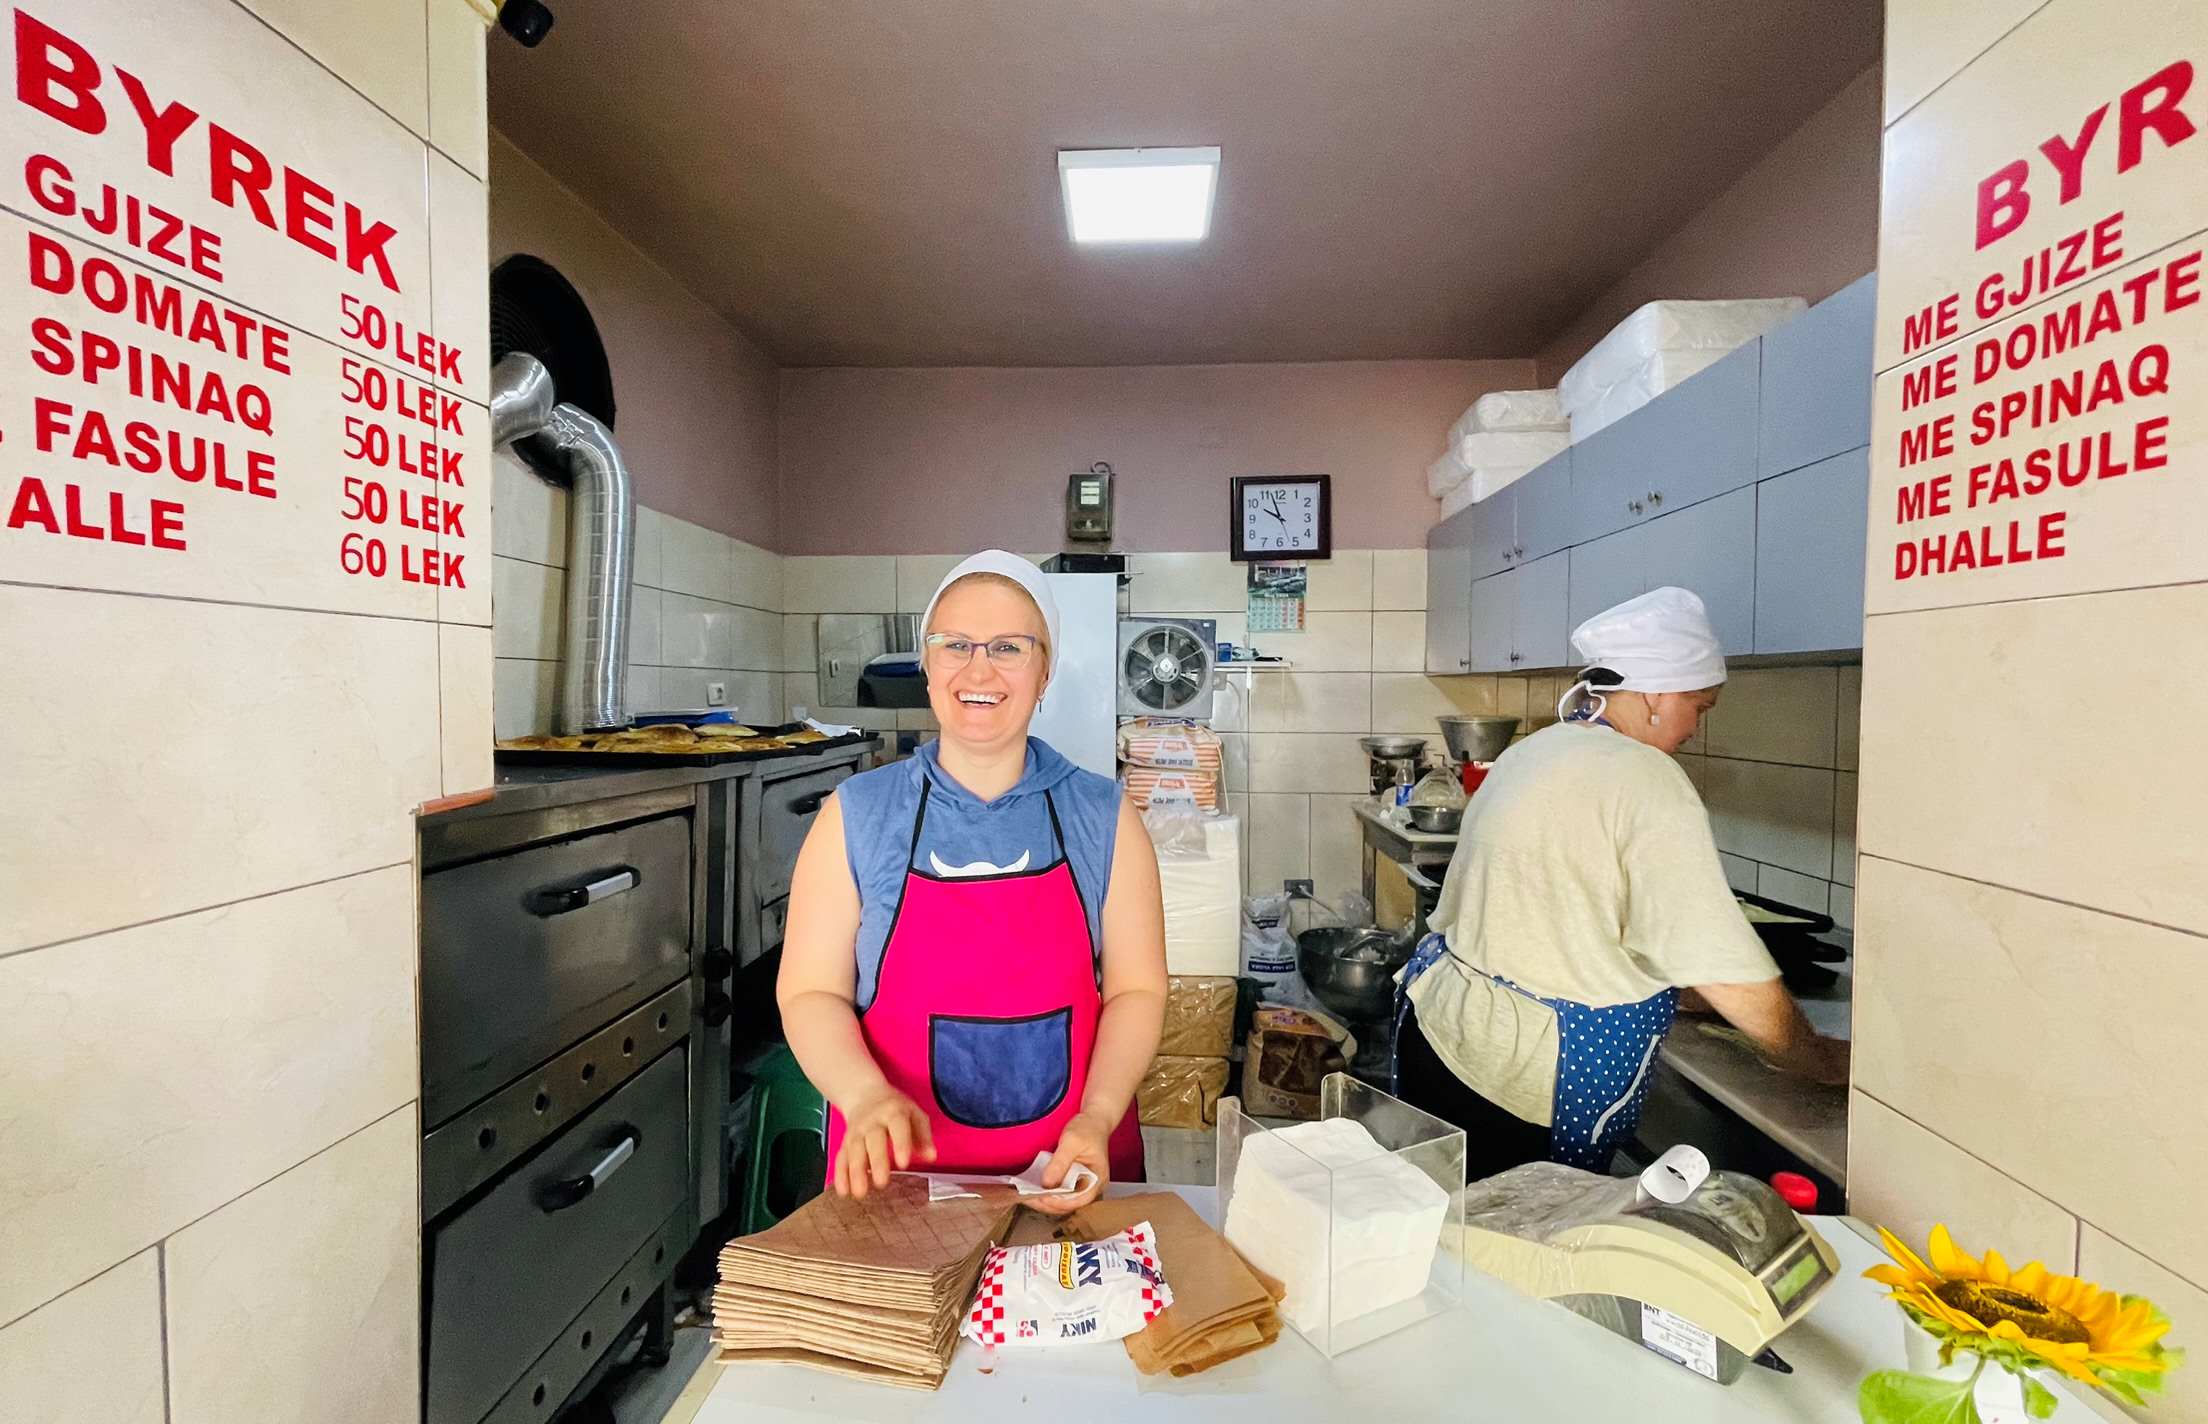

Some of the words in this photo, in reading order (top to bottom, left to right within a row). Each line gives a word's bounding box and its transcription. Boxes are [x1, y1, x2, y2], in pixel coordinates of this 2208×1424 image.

[13, 8, 401, 293] BYREK
[1975, 59, 2208, 252] BYR
[23, 153, 225, 284] GJIZE
[27, 230, 292, 377] DOMATE
[1903, 294, 1960, 354] ME
[1974, 211, 2125, 321] GJIZE
[340, 293, 388, 351] 50
[394, 321, 464, 385] LEK
[1902, 353, 1959, 411] ME
[1973, 250, 2204, 385] DOMATE
[31, 316, 274, 437] SPINAQ
[341, 357, 389, 412] 50
[395, 378, 465, 437] LEK
[1899, 414, 1956, 468] ME
[1969, 343, 2171, 447] SPINAQ
[33, 396, 278, 500] FASULE
[344, 415, 391, 468] 50
[397, 433, 465, 487] LEK
[1896, 474, 1953, 526] ME
[1967, 415, 2171, 509] FASULE
[7, 475, 188, 552] ALLE
[341, 476, 389, 525] 50
[399, 489, 466, 539] LEK
[1247, 497, 1260, 509] 10
[1248, 513, 1257, 525] 9
[1259, 489, 1271, 501] 11
[1274, 488, 1287, 501] 12
[1303, 496, 1312, 508] 2
[1303, 512, 1312, 524] 3
[339, 532, 388, 578] 60
[400, 543, 467, 590] LEK
[1248, 528, 1257, 541] 8
[1260, 536, 1269, 548] 7
[1275, 536, 1284, 548] 6
[1291, 536, 1300, 548] 5
[1303, 527, 1312, 539] 4
[1894, 511, 2068, 581] DHALLE
[1075, 1243, 1102, 1287] IKY
[1059, 1317, 1097, 1338] NIKY
